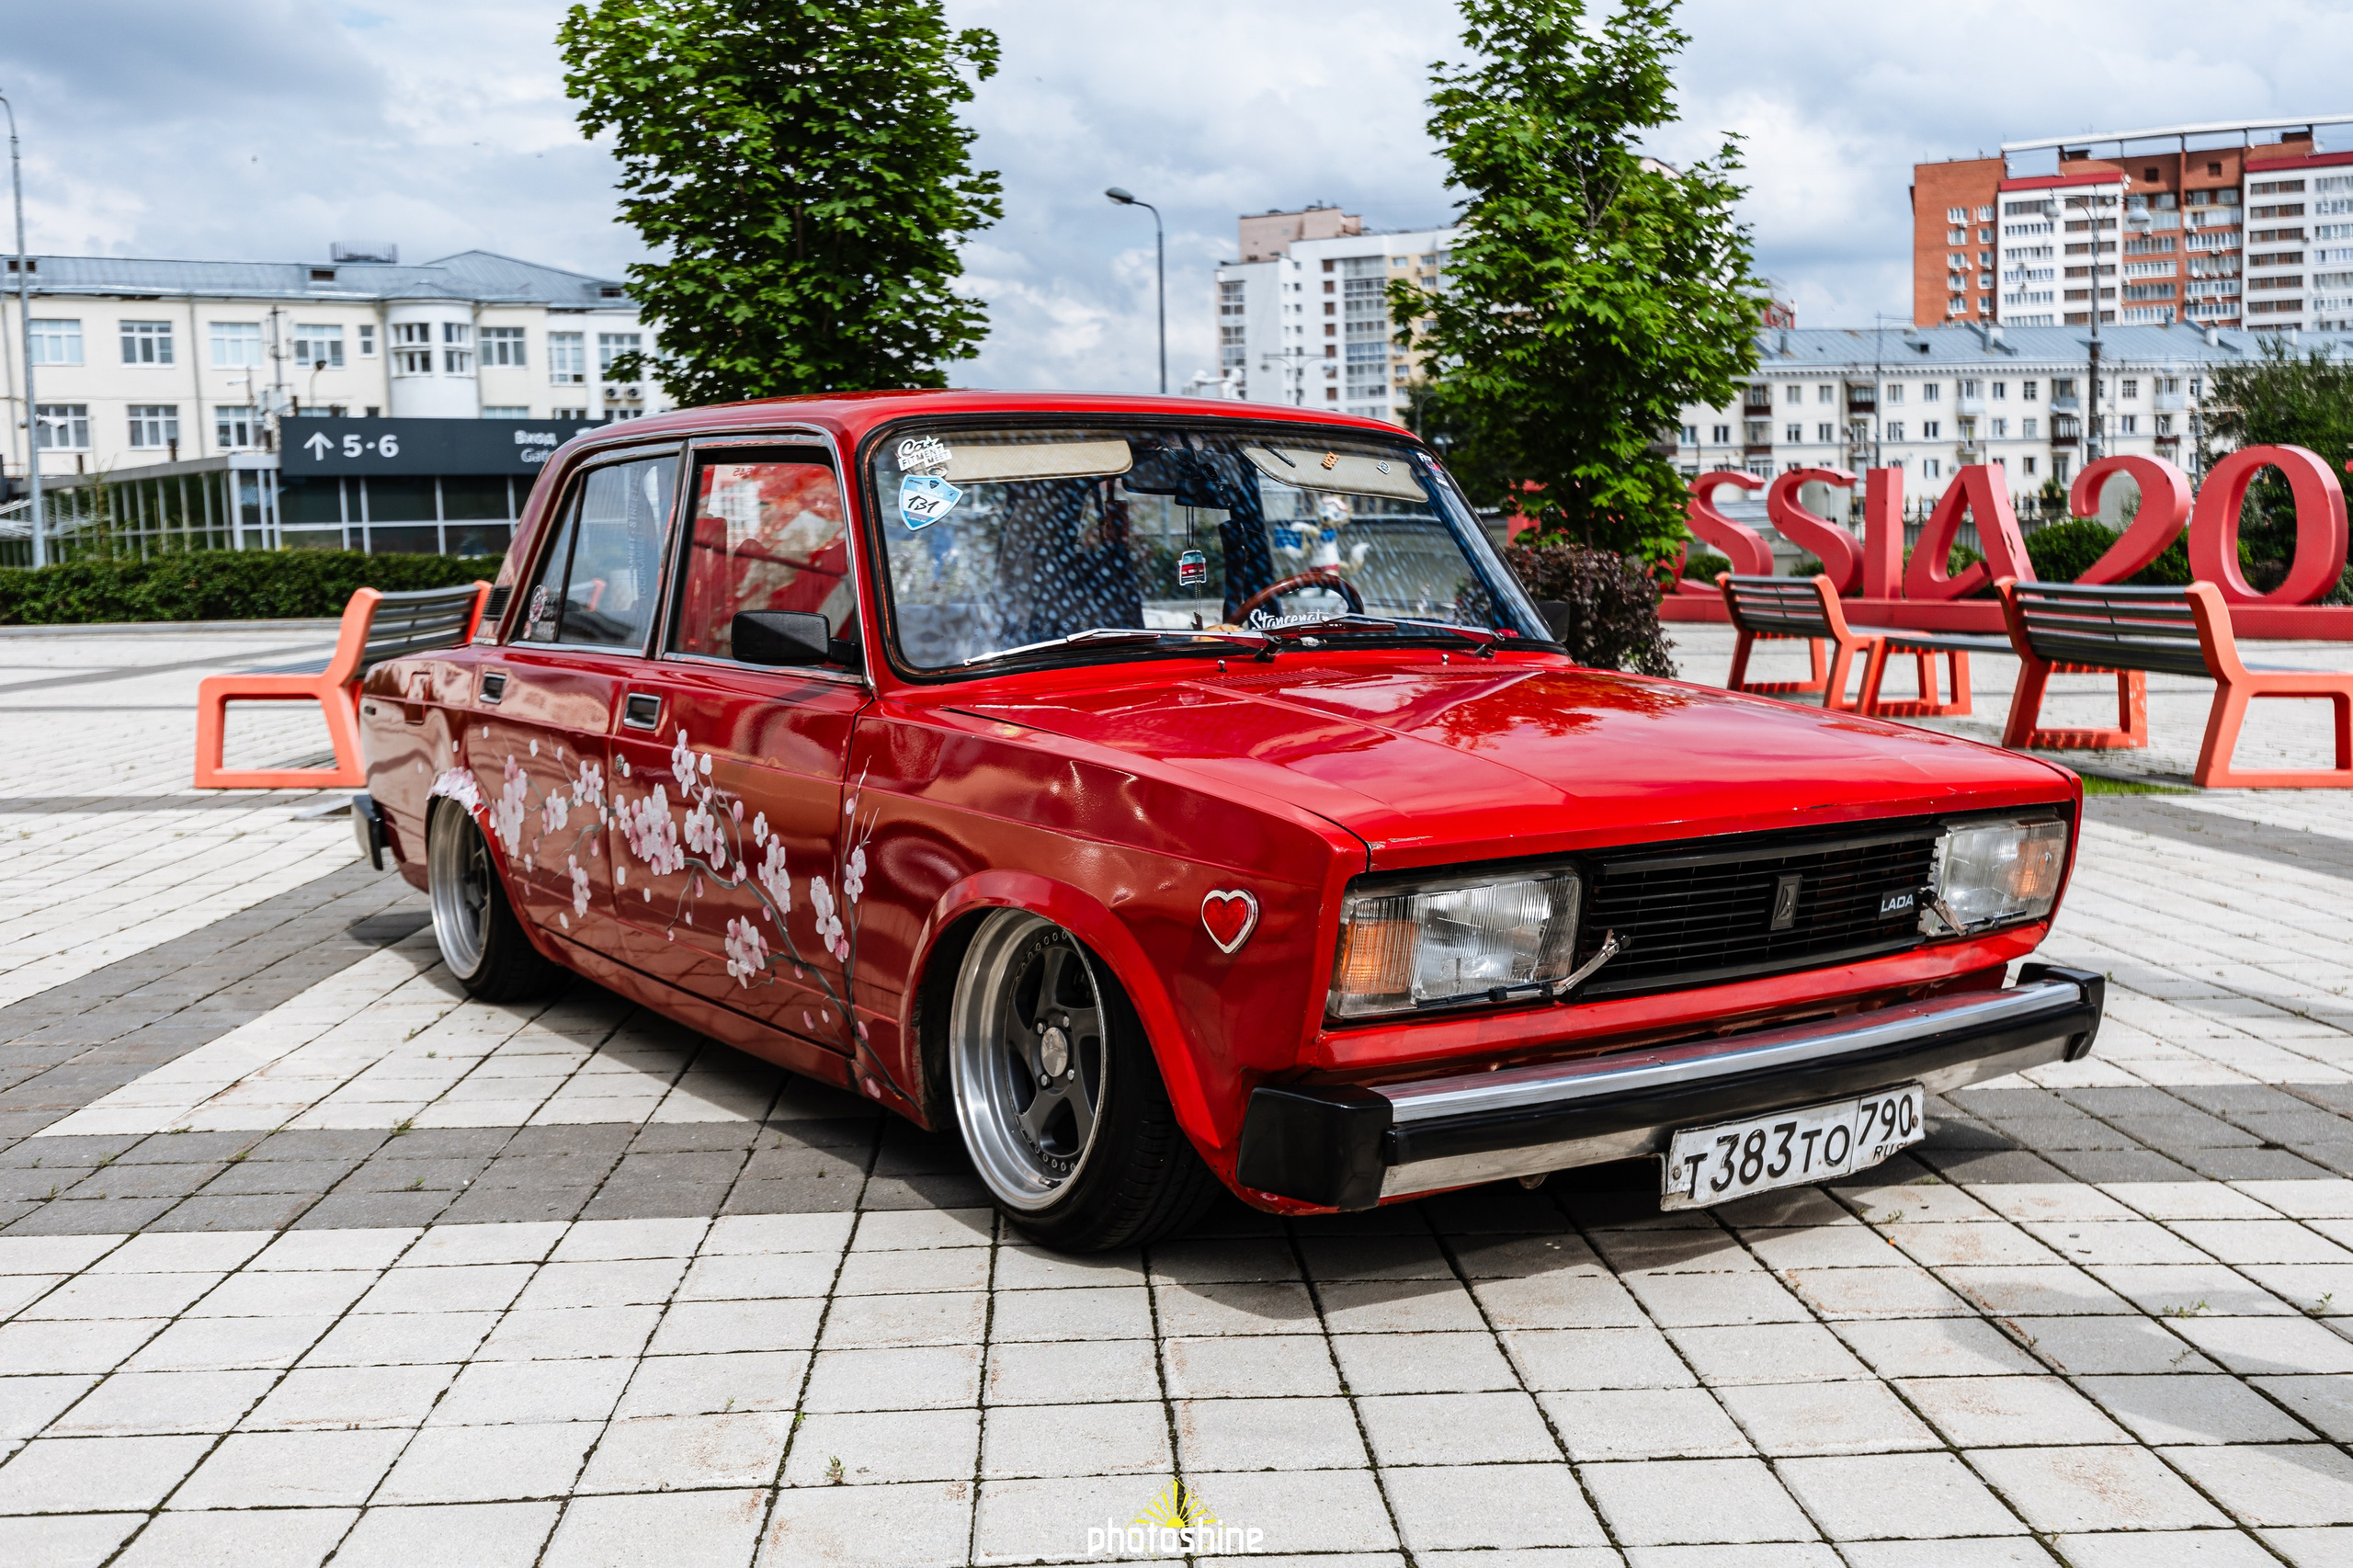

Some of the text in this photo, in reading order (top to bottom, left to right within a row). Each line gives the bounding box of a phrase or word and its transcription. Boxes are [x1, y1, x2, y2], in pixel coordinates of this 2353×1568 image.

[515, 430, 557, 446] Вход
[902, 446, 942, 467] FITMENT
[927, 451, 949, 463] MEET
[907, 495, 940, 513] 131
[2071, 444, 2353, 606] 20
[1249, 608, 1330, 630] Stancenat
[1881, 894, 1914, 913] LADA
[1858, 1094, 1914, 1146] 790
